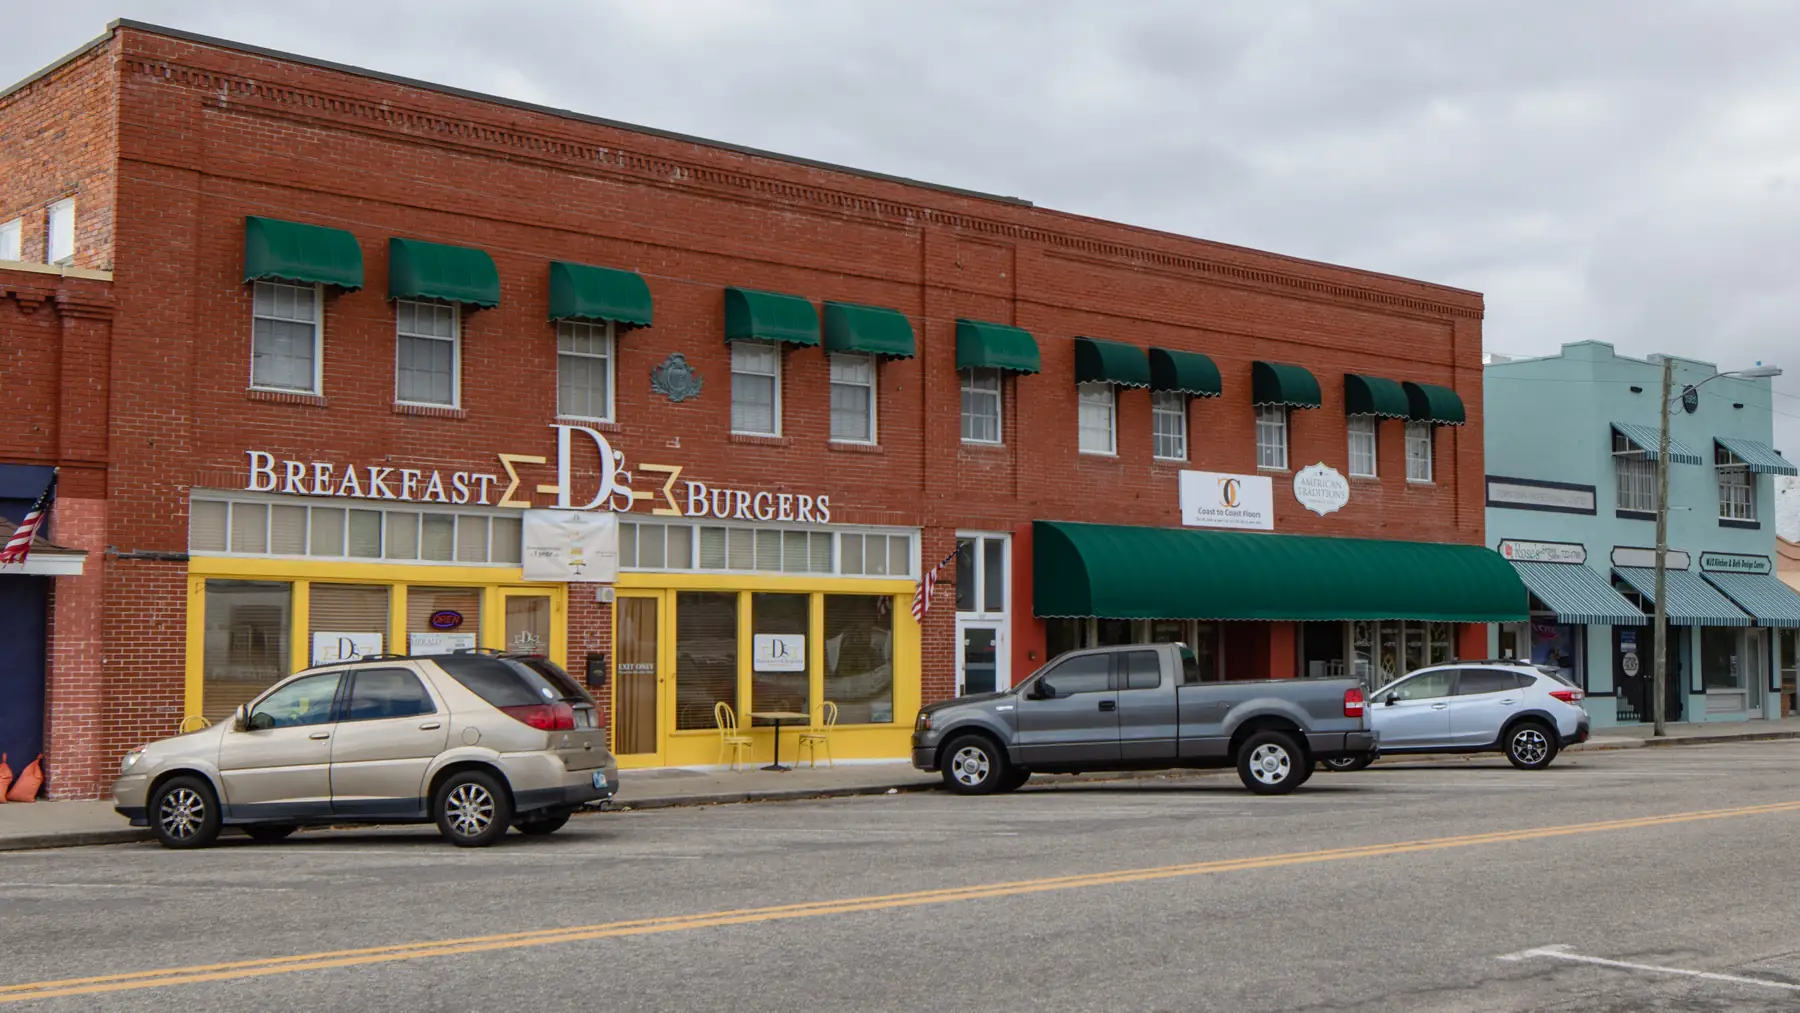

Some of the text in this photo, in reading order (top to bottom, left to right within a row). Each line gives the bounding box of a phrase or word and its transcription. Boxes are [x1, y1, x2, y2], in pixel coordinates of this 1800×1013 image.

[245, 450, 497, 505] BREAKFAST
[684, 480, 831, 524] BURGERS
[1198, 507, 1216, 516] Coast
[1224, 509, 1241, 518] Coast
[1242, 510, 1262, 519] Floors
